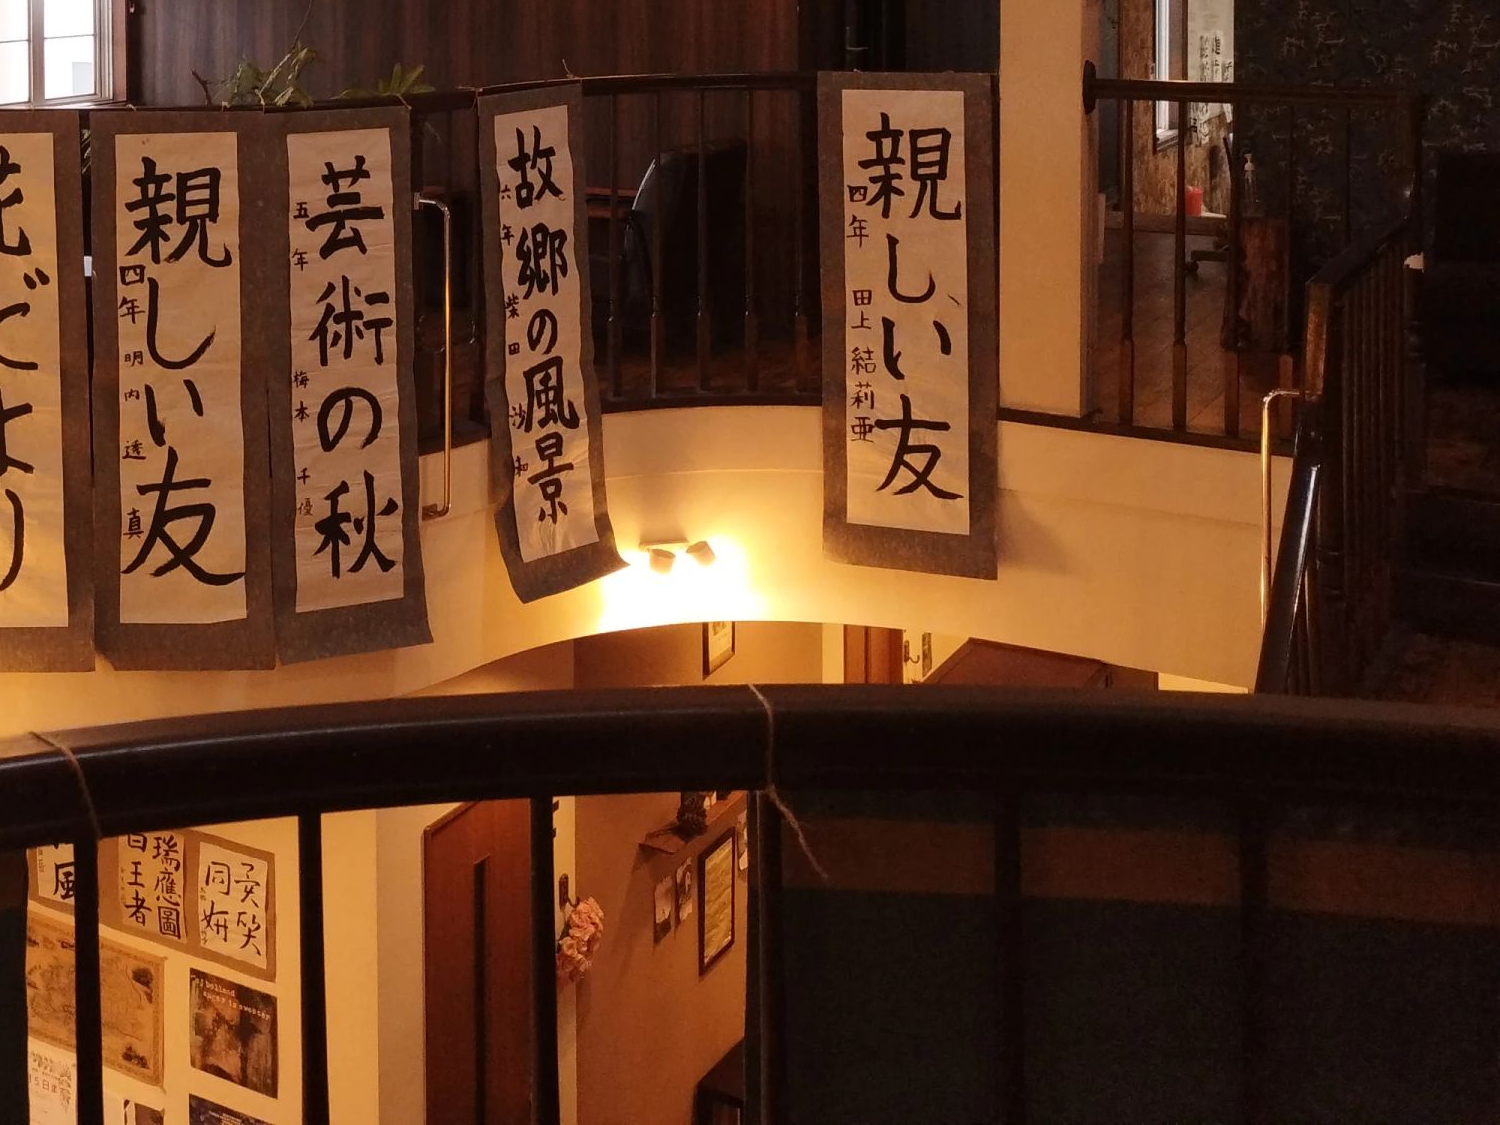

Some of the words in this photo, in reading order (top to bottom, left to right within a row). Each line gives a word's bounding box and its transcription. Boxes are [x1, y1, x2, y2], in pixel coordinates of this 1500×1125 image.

[121, 156, 245, 586] 親しい友
[307, 155, 399, 580] 芸術の秋
[508, 124, 581, 525] 故郷の風景
[858, 112, 965, 500] 親しい友
